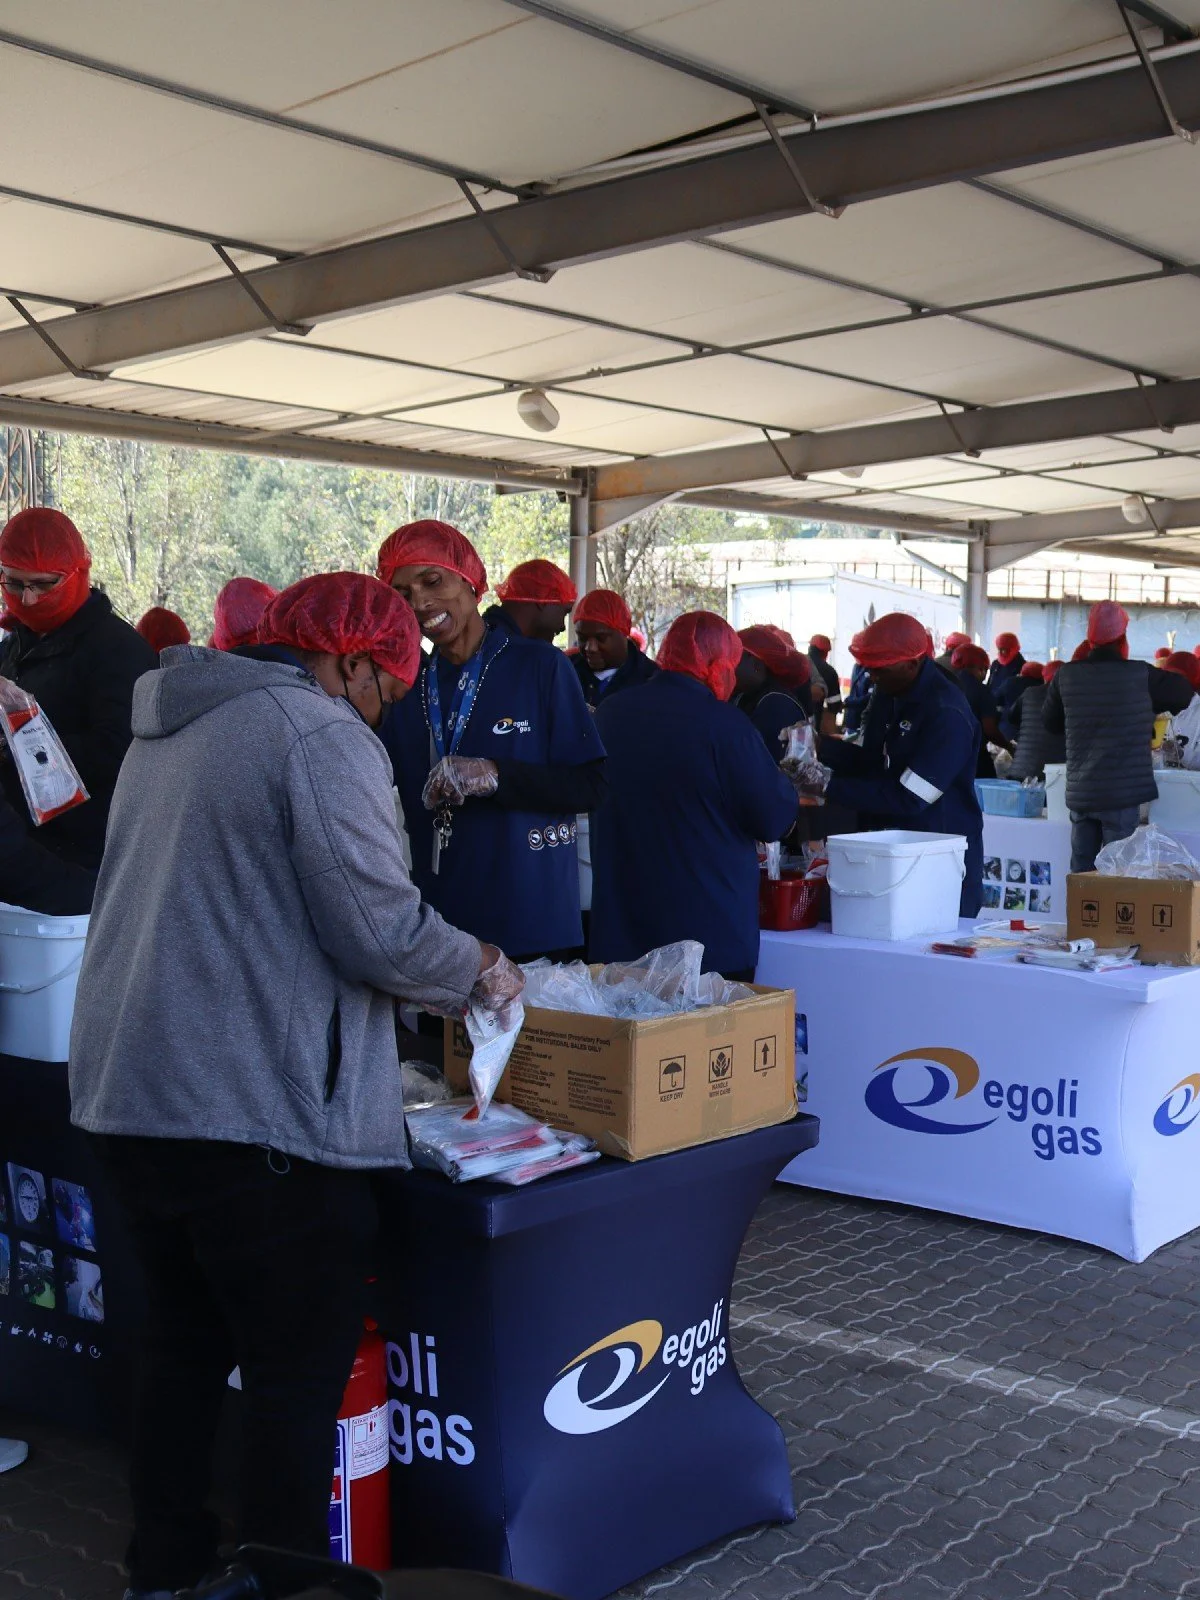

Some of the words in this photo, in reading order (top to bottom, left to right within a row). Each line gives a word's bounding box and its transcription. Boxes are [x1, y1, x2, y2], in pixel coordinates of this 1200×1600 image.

[513, 719, 529, 728] egoli
[519, 725, 531, 734] gas
[660, 1093, 673, 1103] KEEP
[673, 1091, 684, 1101] DRY
[711, 1082, 729, 1091] HANDLE
[983, 1078, 1078, 1122] egoli
[1031, 1121, 1102, 1161] gas
[663, 1297, 724, 1368] egoli
[386, 1331, 438, 1398] oli
[690, 1336, 726, 1396] gas
[388, 1398, 476, 1465] gas
